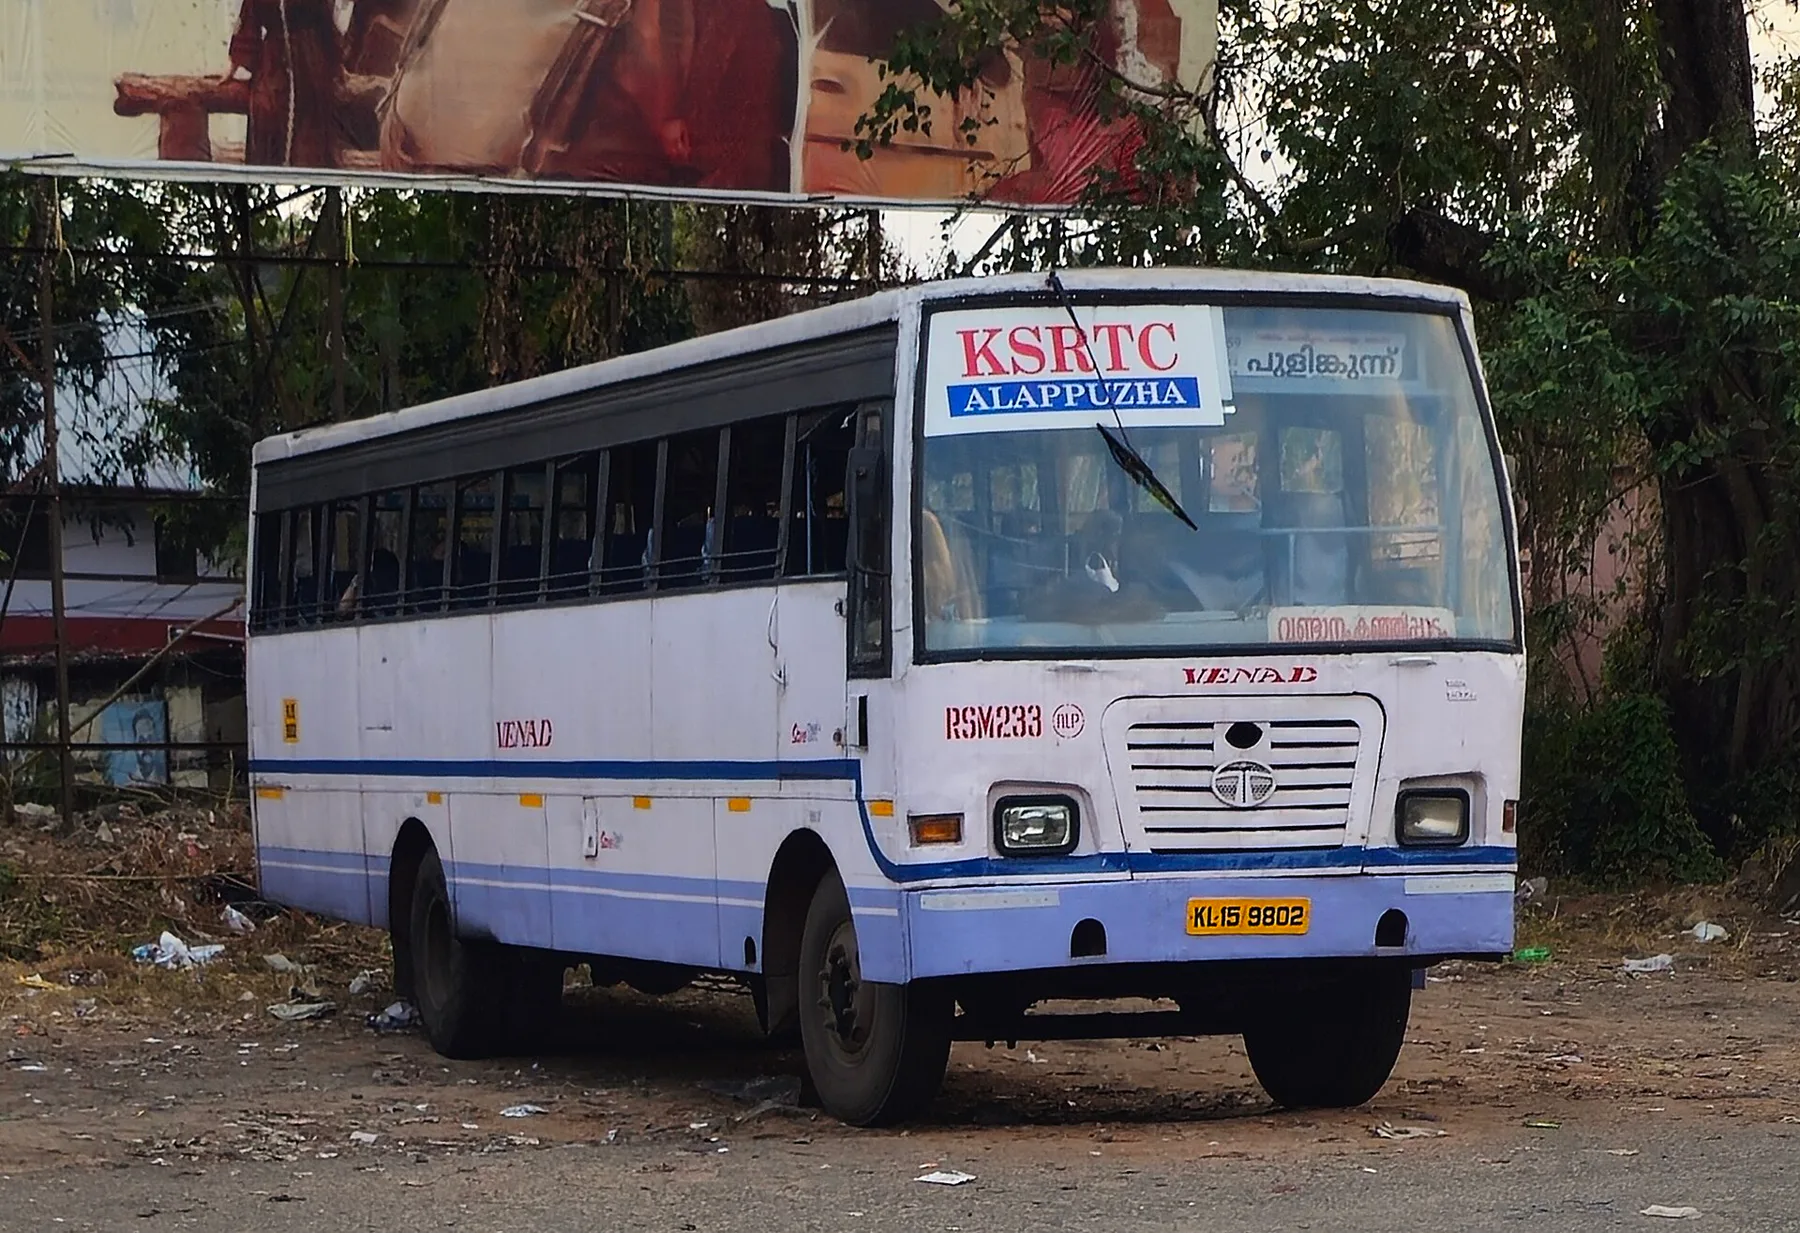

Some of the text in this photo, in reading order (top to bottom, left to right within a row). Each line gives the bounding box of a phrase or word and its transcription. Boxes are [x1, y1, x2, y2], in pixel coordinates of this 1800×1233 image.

[956, 322, 1178, 378] KSRTC
[1247, 344, 1399, 379] പുളിങ്കുന്ന്
[964, 381, 1187, 412] ALAPPUZHA
[1182, 667, 1318, 685] VENAD
[496, 719, 552, 748] VENAD
[946, 705, 1042, 739] RSM233
[1247, 906, 1304, 927] 9802
